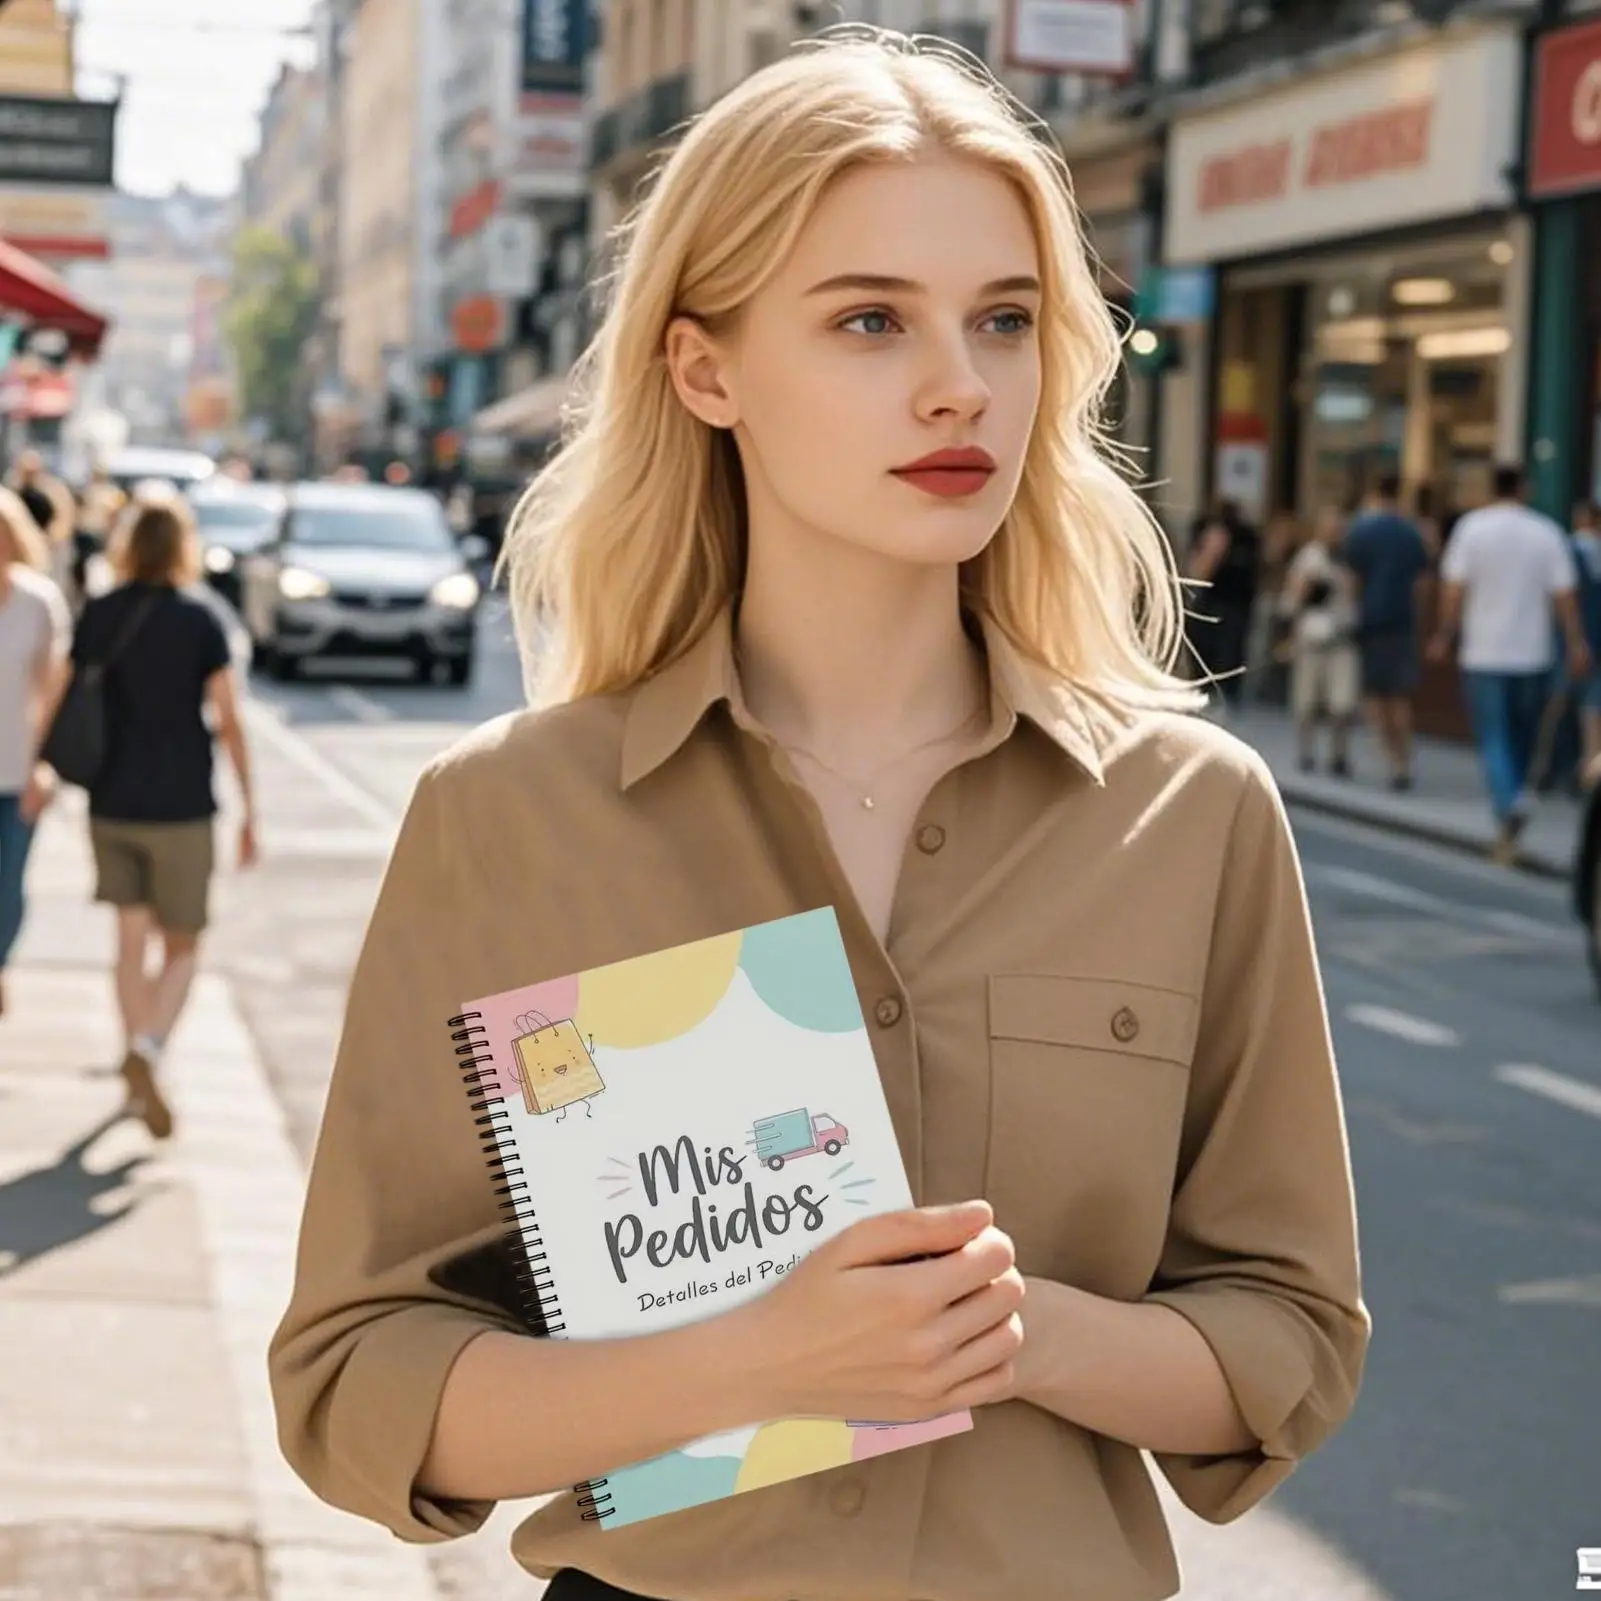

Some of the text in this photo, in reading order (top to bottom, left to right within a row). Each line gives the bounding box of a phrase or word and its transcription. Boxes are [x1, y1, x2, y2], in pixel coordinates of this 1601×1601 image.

[639, 1136, 747, 1207] Mis
[604, 1181, 829, 1284] Pedidos
[637, 1249, 811, 1312] Detalles del Pedi
